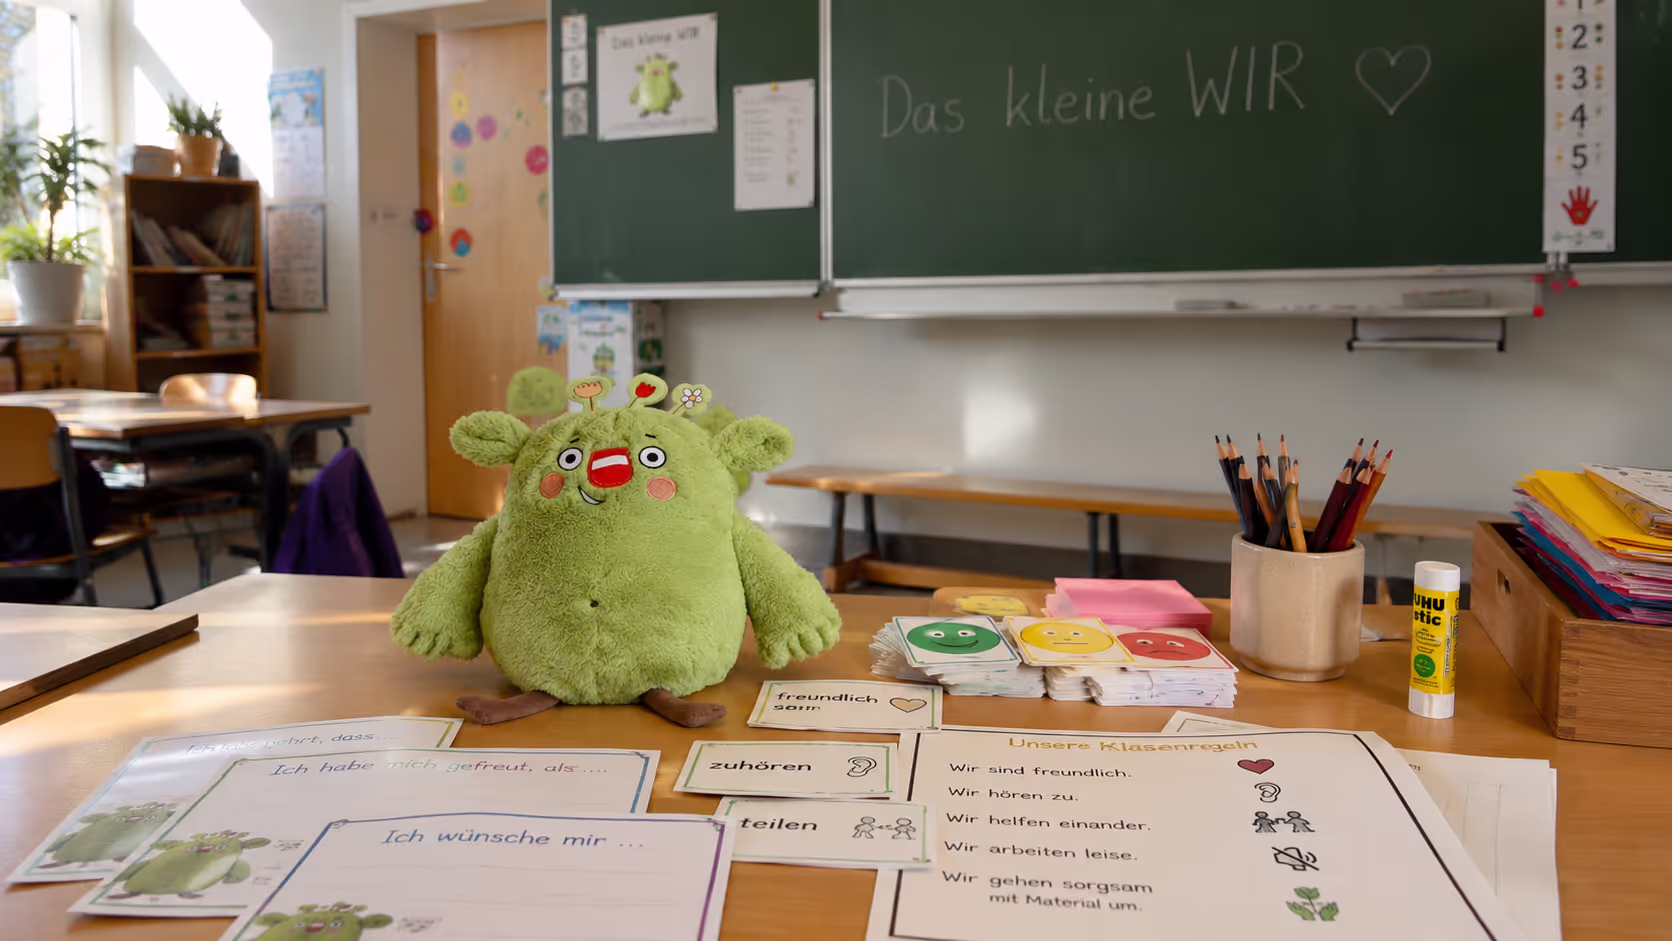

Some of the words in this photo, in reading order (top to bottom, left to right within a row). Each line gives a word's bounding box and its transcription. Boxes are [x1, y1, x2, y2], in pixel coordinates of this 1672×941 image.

[1571, 24, 1588, 49] 2
[1571, 65, 1588, 90] 3
[878, 74, 965, 138] Das
[1006, 63, 1156, 127] kleine
[1186, 40, 1305, 118] WIR
[1570, 103, 1588, 129] 4
[1571, 144, 1588, 169] 5
[1414, 592, 1445, 611] UHU
[1414, 610, 1441, 626] stic
[777, 691, 878, 704] freundlich
[1008, 737, 1090, 750] Unsere
[269, 764, 308, 776] Ich
[319, 760, 375, 773] habe
[385, 758, 438, 770] mich
[446, 760, 533, 773] gefreut,
[709, 760, 812, 772] zuhören
[949, 763, 979, 773] Wir
[988, 765, 1025, 775] sind
[1032, 766, 1132, 778] freundlich.
[948, 787, 979, 798] Wir
[988, 788, 1043, 801] hören
[1051, 793, 1079, 802] zu.
[740, 817, 818, 831] teilen
[946, 812, 979, 823] Wir
[989, 815, 1050, 828] helfen
[1059, 820, 1151, 831] einander.
[381, 829, 424, 844] Ich
[437, 829, 550, 845] wünsche
[562, 834, 607, 847] mir
[944, 841, 979, 852] Wir
[989, 845, 1076, 858] arbeiten
[1085, 848, 1138, 861] leise.
[942, 870, 978, 883] Wir
[989, 875, 1053, 888] gehen
[1062, 880, 1153, 894] sorgsam
[989, 893, 1019, 904] mit
[1025, 894, 1101, 910] Material
[1108, 902, 1143, 912] um.
